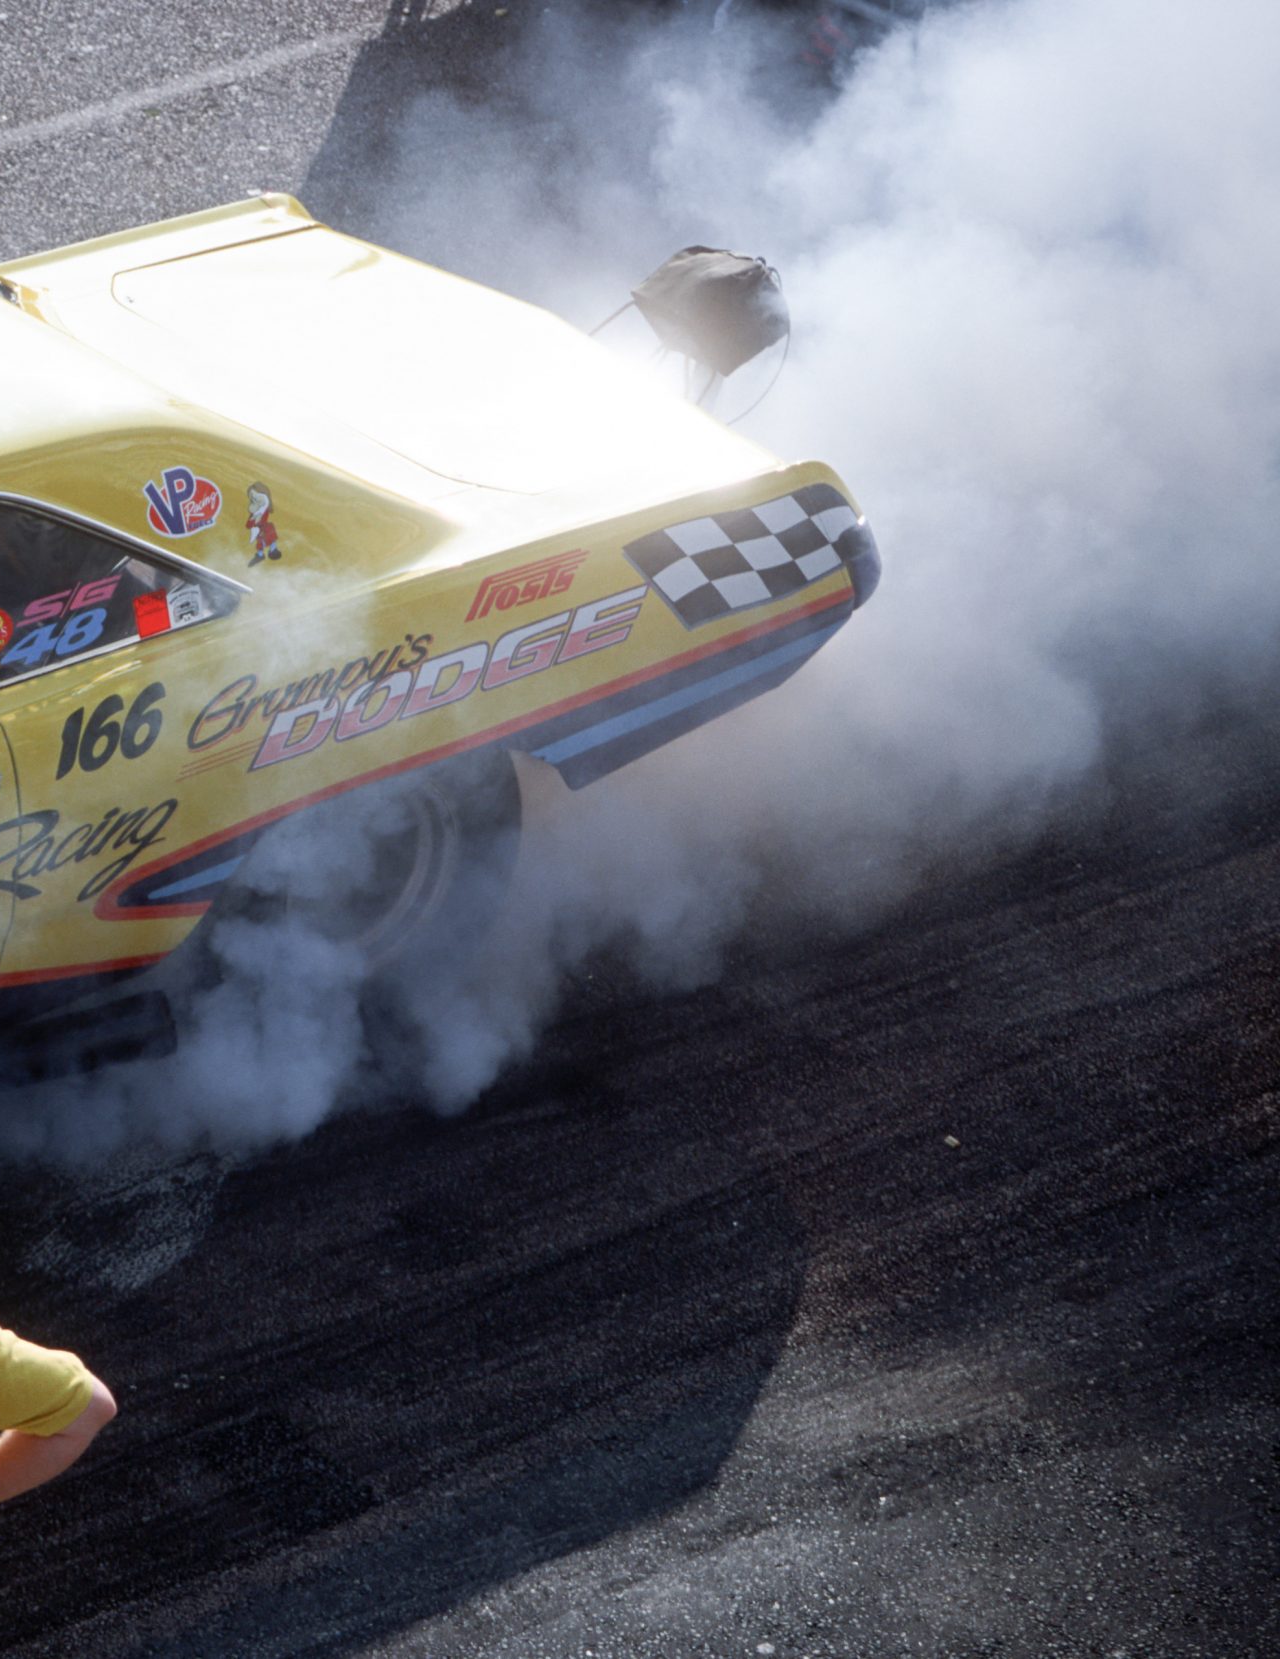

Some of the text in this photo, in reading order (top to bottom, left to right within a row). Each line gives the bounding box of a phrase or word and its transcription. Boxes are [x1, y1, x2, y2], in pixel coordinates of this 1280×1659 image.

[144, 467, 195, 534] VP
[183, 491, 217, 526] Racing
[0, 607, 107, 665] 48
[187, 634, 432, 751] Grumpy's
[247, 583, 650, 773] DODGE
[56, 681, 166, 780] 166
